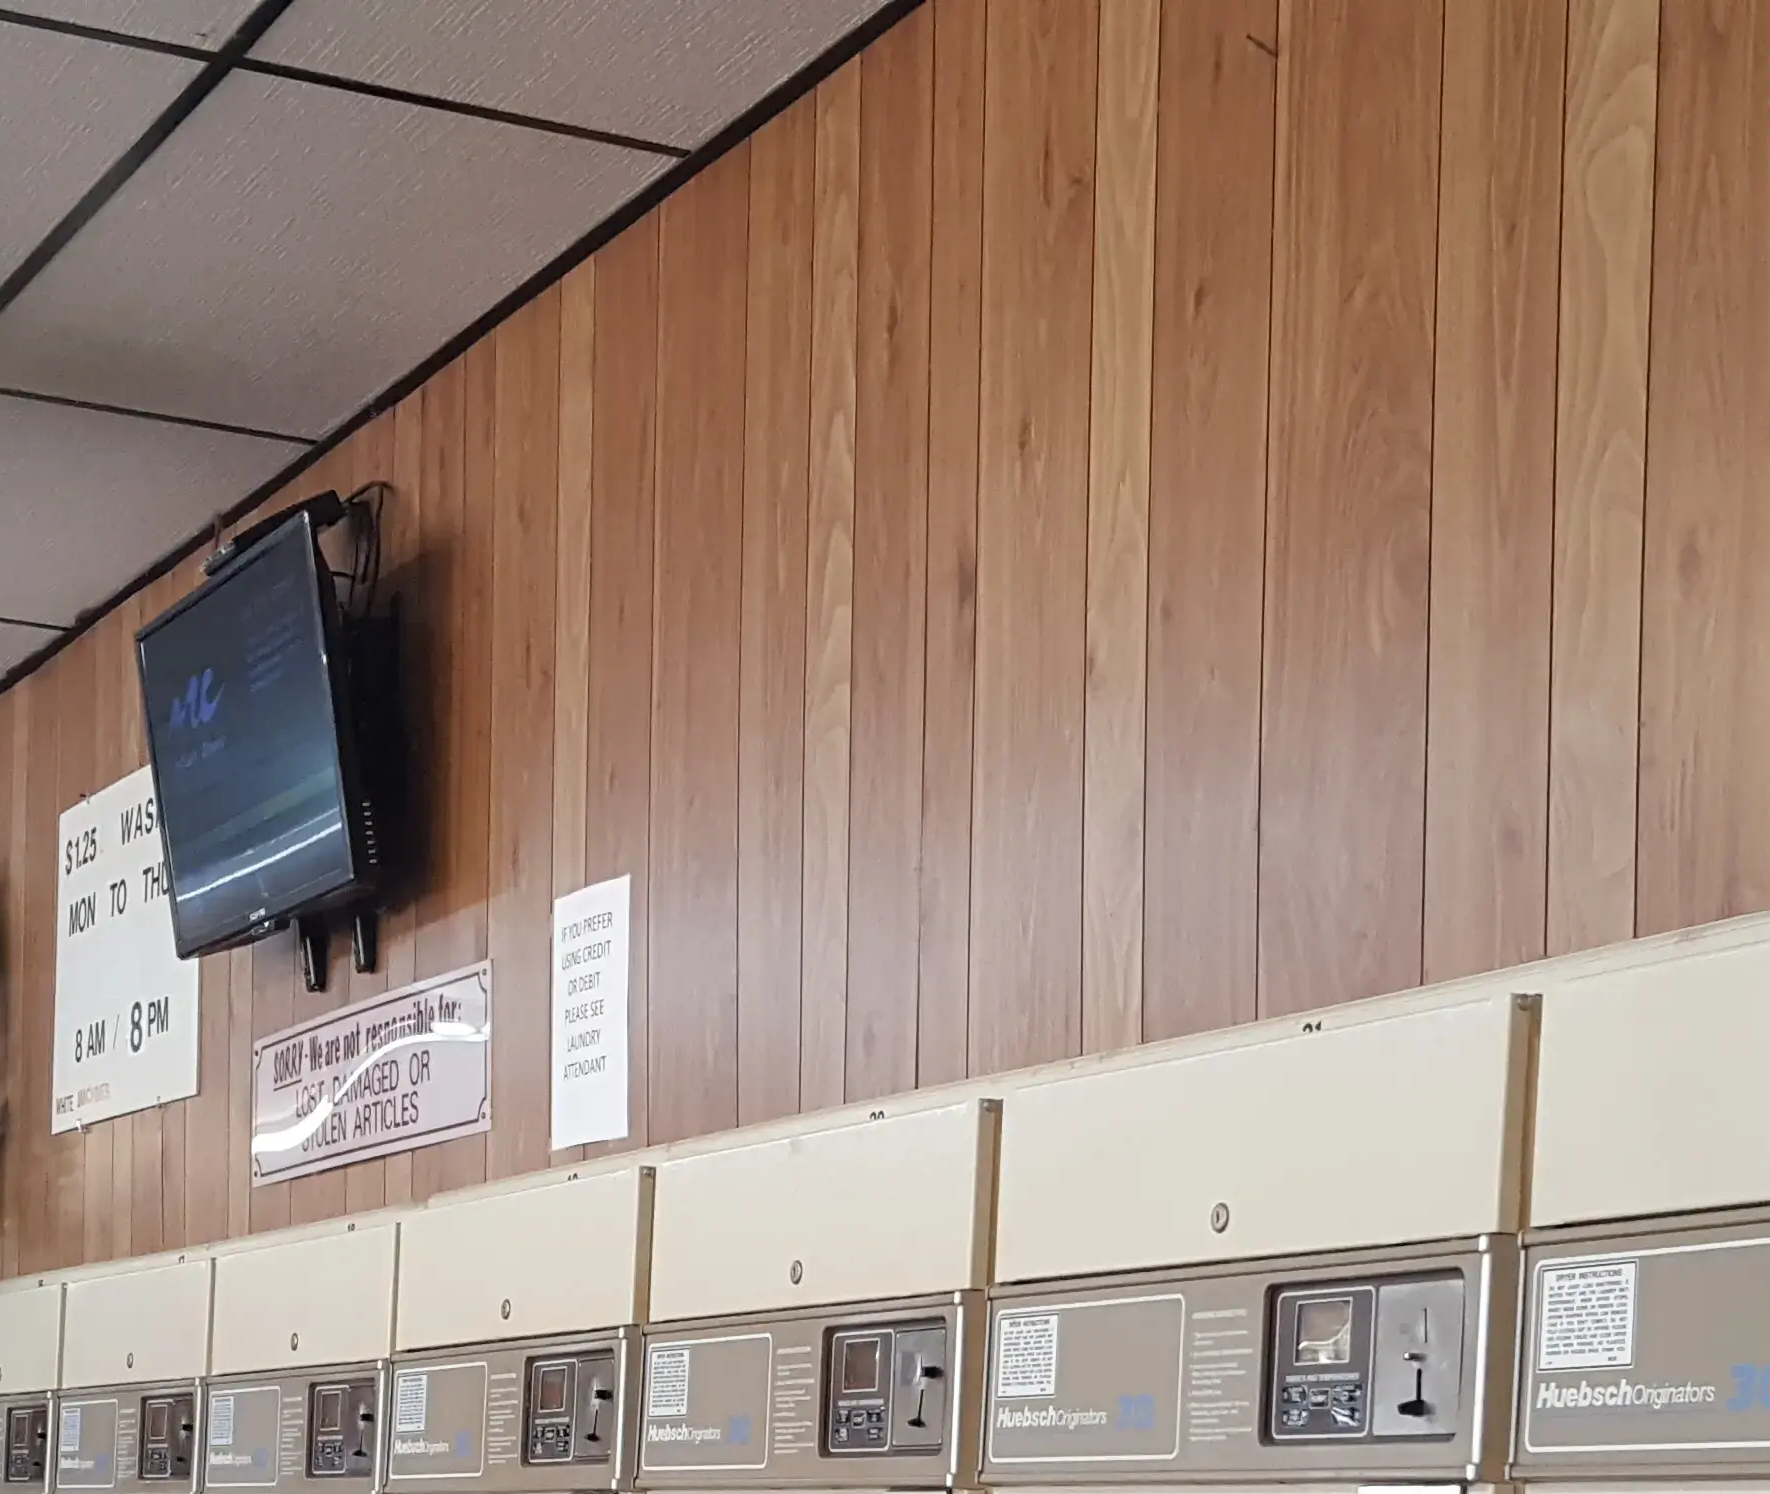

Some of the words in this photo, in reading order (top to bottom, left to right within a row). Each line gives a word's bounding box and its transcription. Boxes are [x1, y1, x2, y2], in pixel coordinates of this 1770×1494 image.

[65, 828, 97, 876] $1.25
[120, 797, 161, 846] WAS
[69, 892, 96, 937] MON
[109, 879, 127, 917] TO
[561, 925, 568, 943] IF
[569, 921, 583, 940] YOU
[583, 911, 613, 934] PREFER
[561, 949, 582, 971] USING
[583, 939, 612, 962] CREDIT
[567, 979, 577, 997] OR
[579, 971, 601, 991] DEBIT
[74, 1029, 83, 1063] 8
[87, 1019, 106, 1057] AM
[129, 1001, 143, 1053] 8
[147, 996, 170, 1038] PM
[565, 1006, 590, 1027] PLEASE
[590, 998, 605, 1017] SEE
[325, 1042, 341, 1068] are
[343, 1021, 361, 1062] not
[567, 1028, 602, 1053] LAUNDRY
[332, 1059, 400, 1107] DAMAGED
[408, 1049, 431, 1086] OR
[563, 1055, 607, 1081] ATTENDANT
[353, 1091, 419, 1134] ARTICLES
